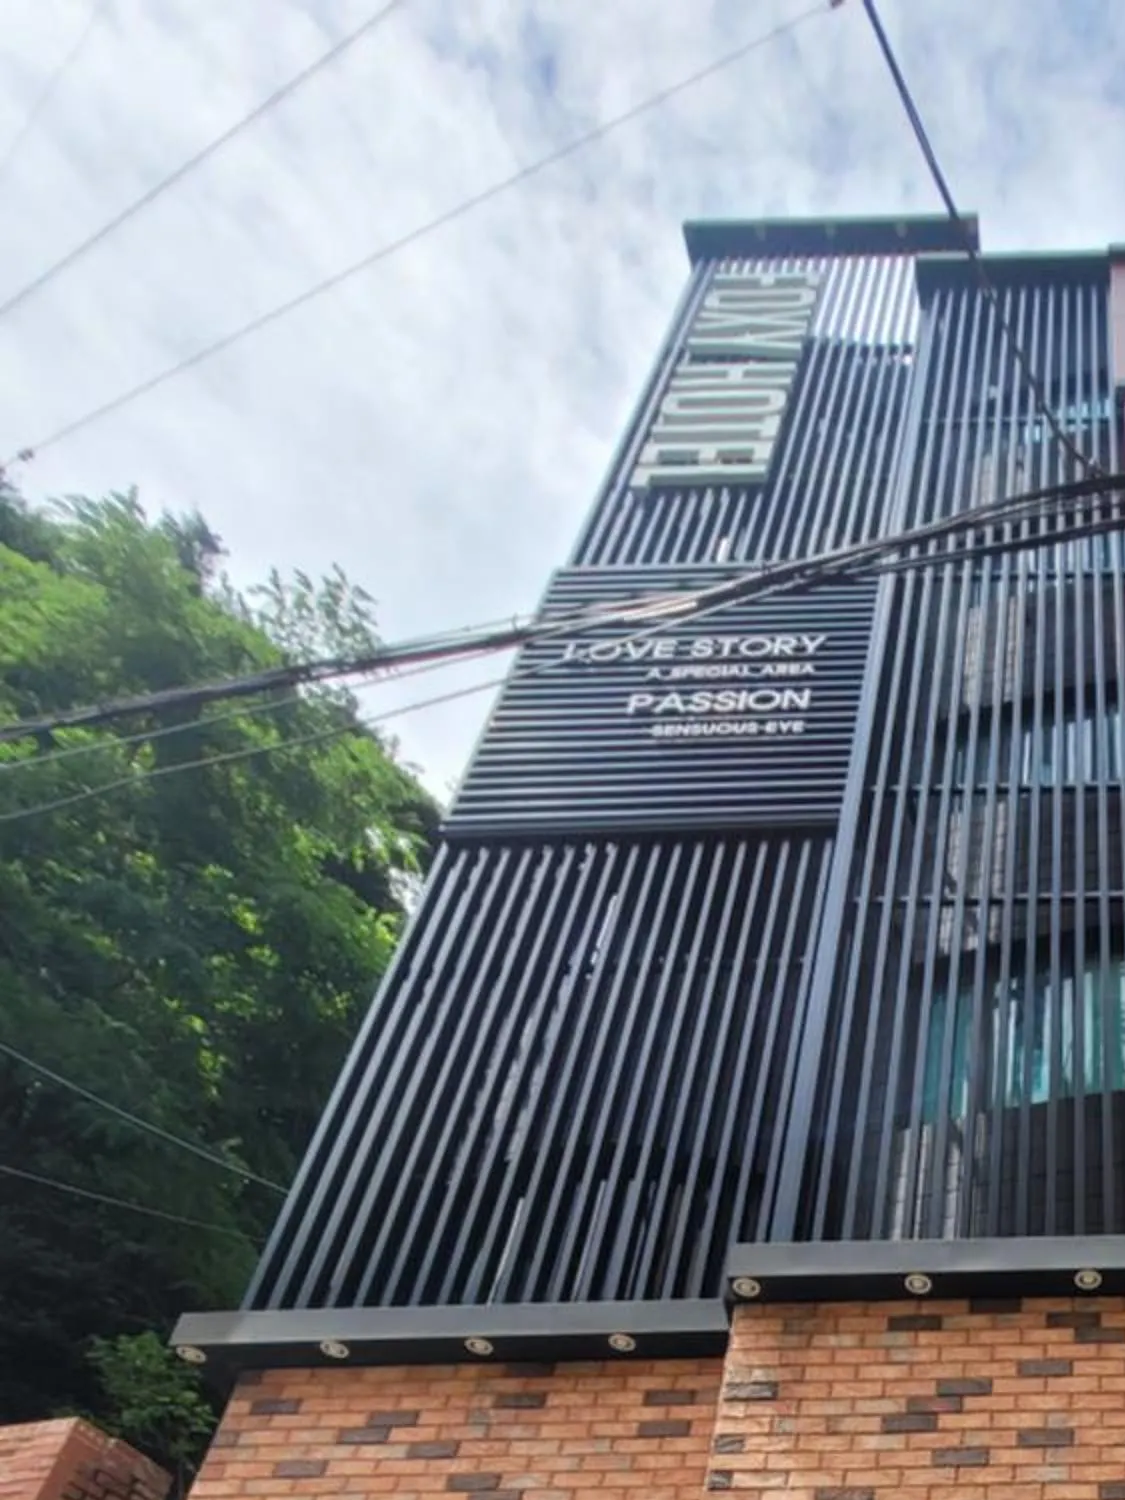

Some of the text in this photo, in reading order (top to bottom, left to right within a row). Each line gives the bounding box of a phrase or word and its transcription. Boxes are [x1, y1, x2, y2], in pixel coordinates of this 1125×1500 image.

[629, 271, 820, 494] FOXY HOTEL
[562, 634, 828, 663] LOVE STORY
[664, 664, 752, 680] SPECIAL
[757, 662, 816, 677] AREA
[626, 687, 813, 716] PASSION
[765, 719, 806, 734] EYE
